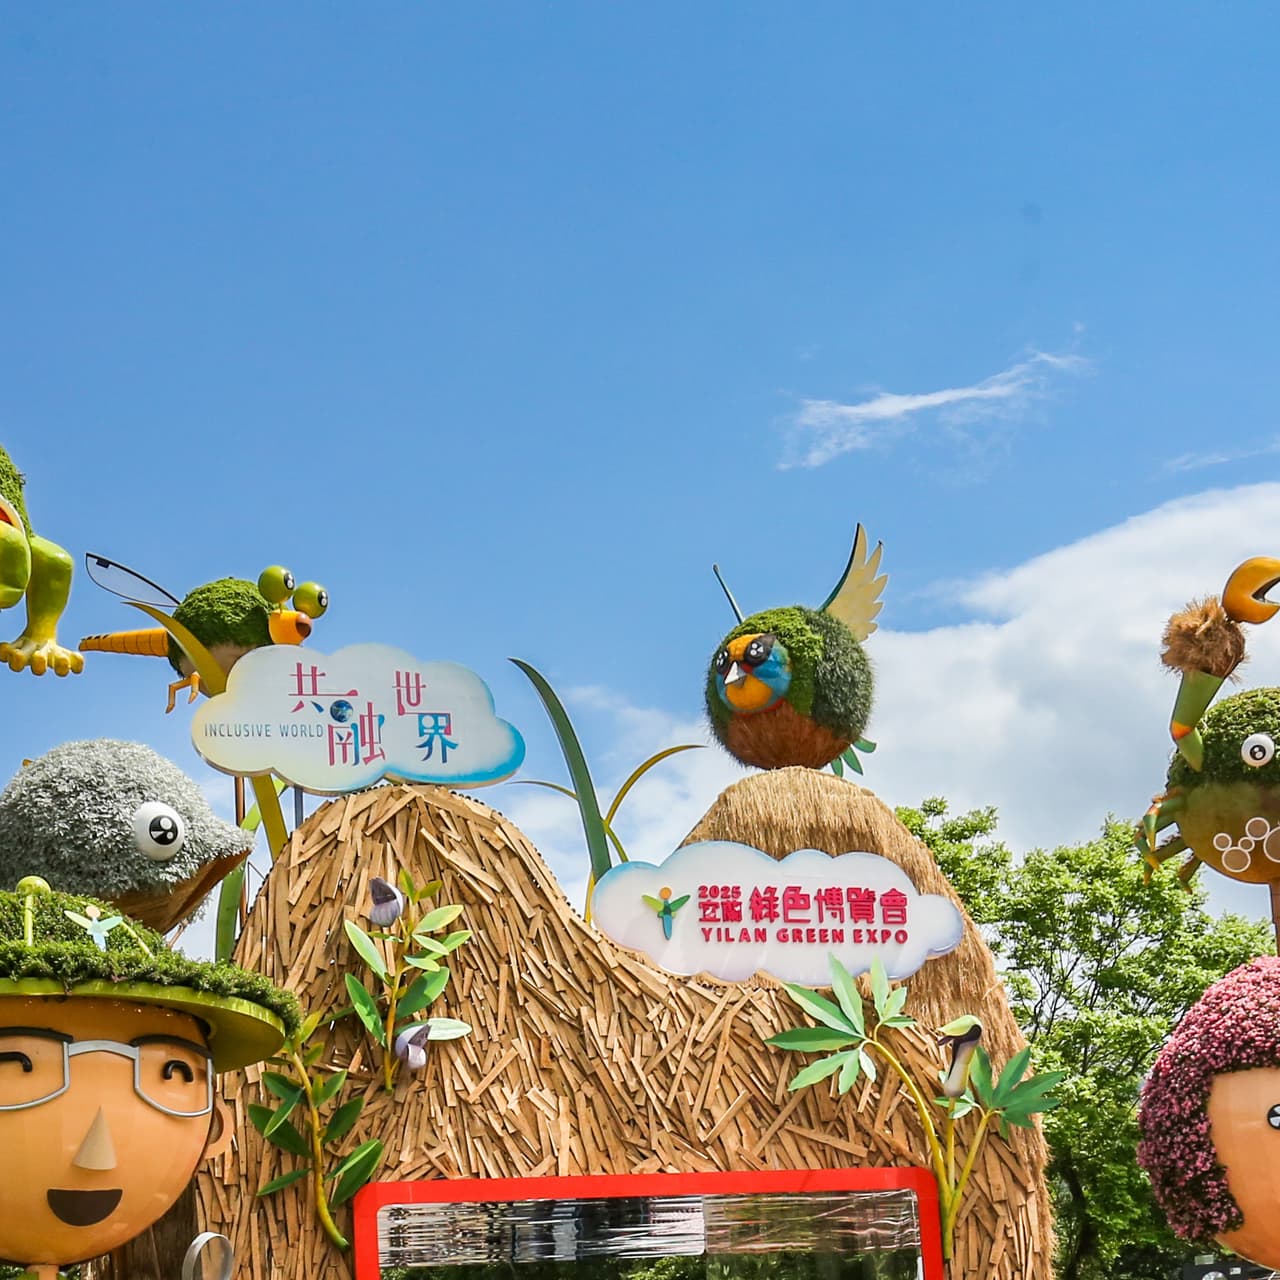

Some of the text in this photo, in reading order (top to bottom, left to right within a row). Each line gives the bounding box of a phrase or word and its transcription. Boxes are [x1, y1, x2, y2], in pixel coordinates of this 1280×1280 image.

[204, 723, 324, 738] INCLUSIVE WORLD
[698, 885, 741, 899] 2025
[698, 900, 742, 922] 宜蘭
[749, 886, 908, 924] 綠色博覽會
[701, 927, 908, 944] YILAN GREEN EXPO
